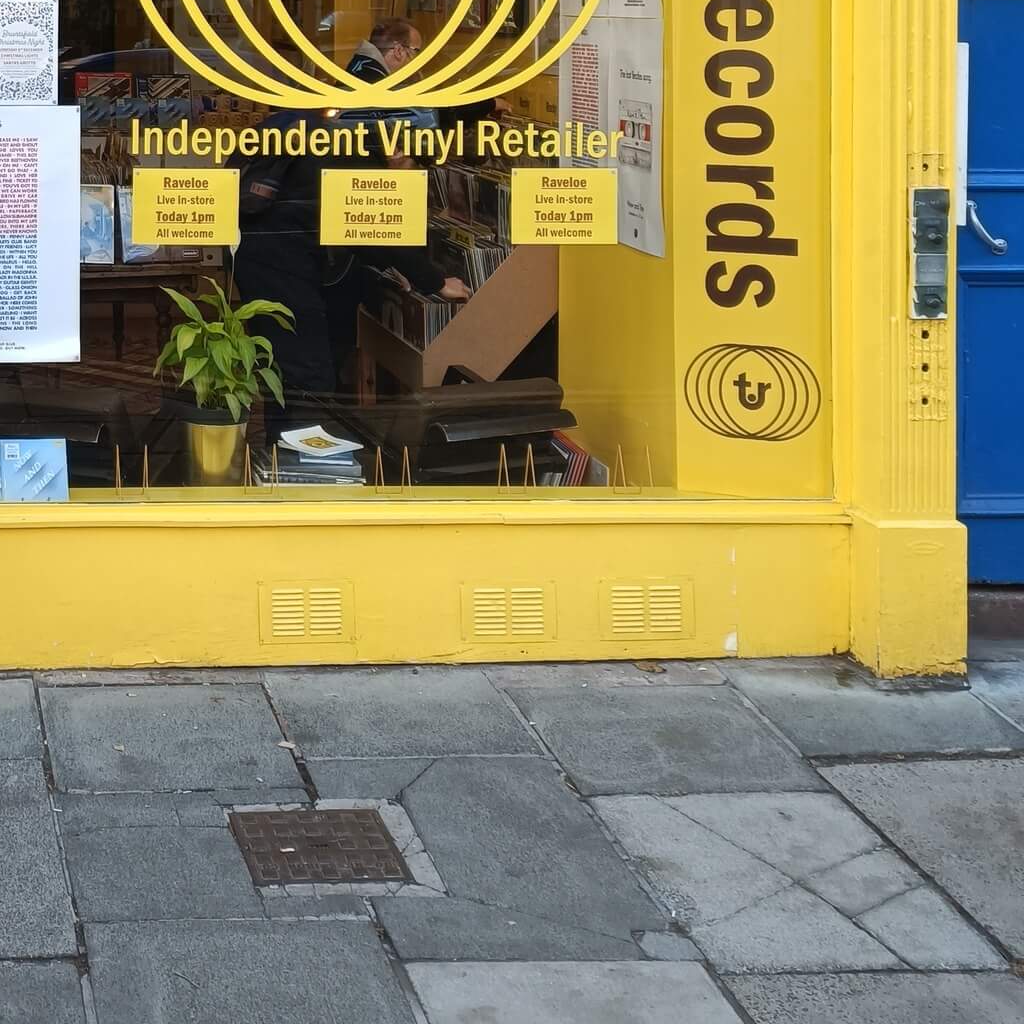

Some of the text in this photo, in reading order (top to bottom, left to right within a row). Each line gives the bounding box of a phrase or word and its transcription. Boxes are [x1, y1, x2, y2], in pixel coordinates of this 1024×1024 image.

[131, 119, 624, 165] Independent Vinyl Retailer
[163, 177, 208, 188] Raveloe
[352, 178, 396, 189] Raveloe
[542, 177, 587, 188] Raveloe
[157, 196, 214, 205] Live in-store
[345, 196, 403, 205] Live in-store
[536, 195, 593, 204] Live in-store
[156, 212, 214, 224] Today 1pm
[344, 212, 403, 224] Today 1pm
[535, 210, 593, 223] Today 1pm
[156, 229, 214, 238] All welcome
[345, 229, 402, 239] All welcome
[535, 228, 592, 237] All welcome
